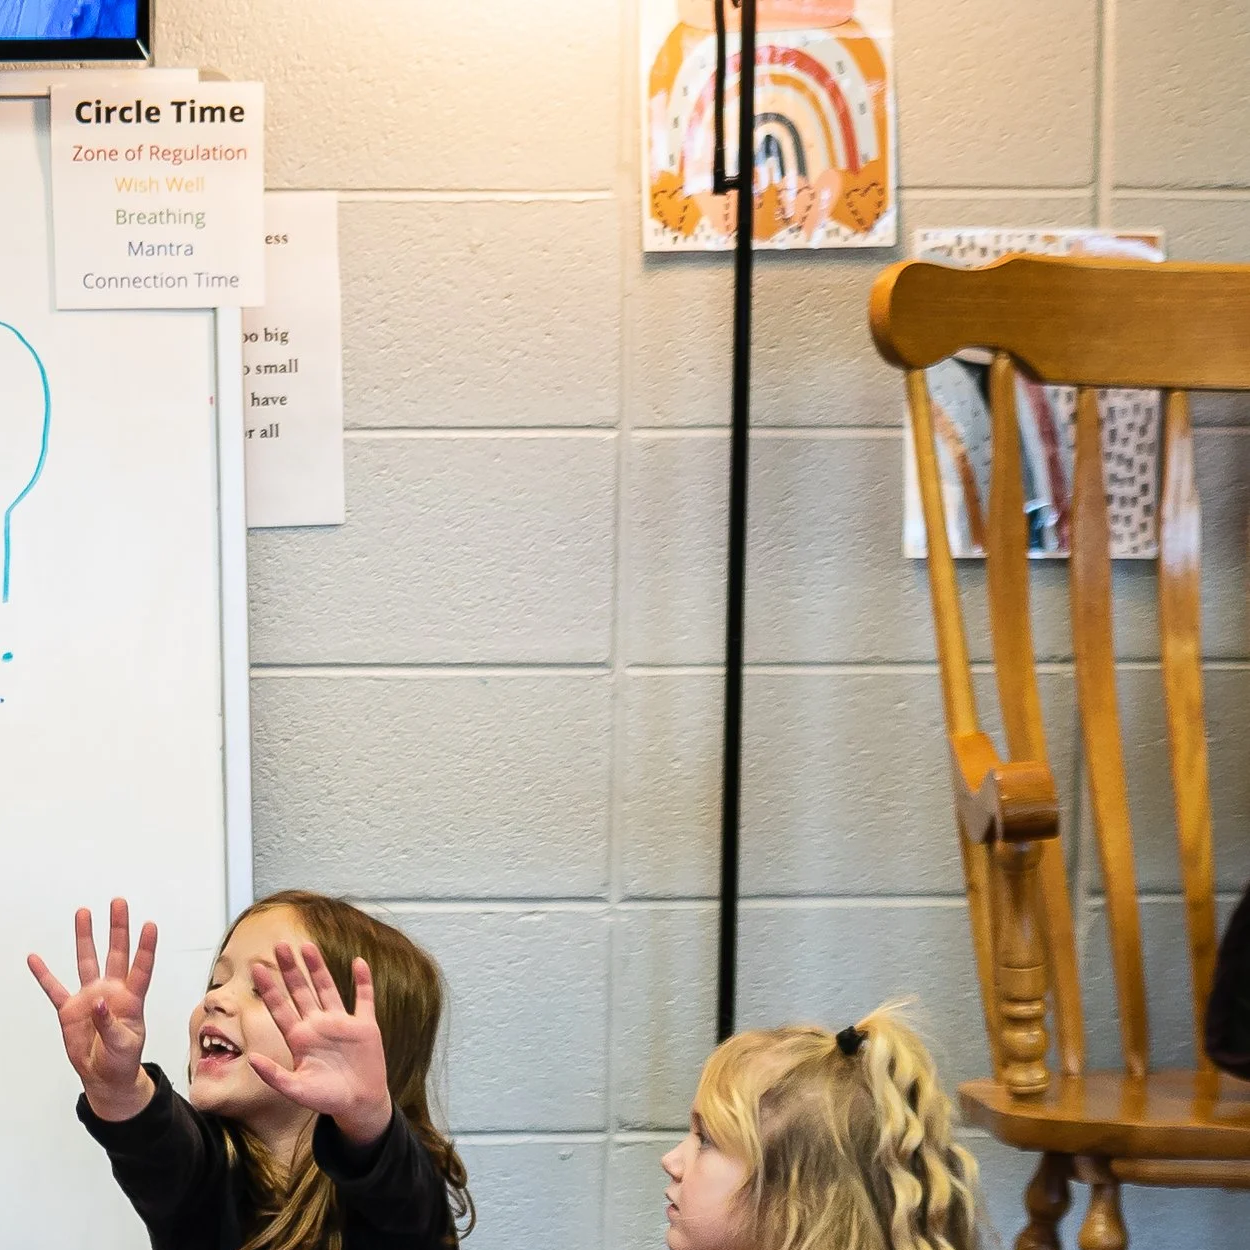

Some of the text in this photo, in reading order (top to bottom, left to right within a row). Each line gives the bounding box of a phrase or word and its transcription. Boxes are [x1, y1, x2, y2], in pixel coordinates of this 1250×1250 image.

[75, 99, 245, 124] Circle Time
[72, 144, 248, 165] Zone of Regulation
[114, 175, 206, 194] Wish Well
[115, 209, 206, 229] Breathing
[127, 240, 194, 257] Mantra
[83, 272, 240, 290] Connection Time
[264, 327, 289, 346] big
[255, 358, 298, 375] small
[251, 391, 288, 407] have
[260, 423, 280, 439] all
